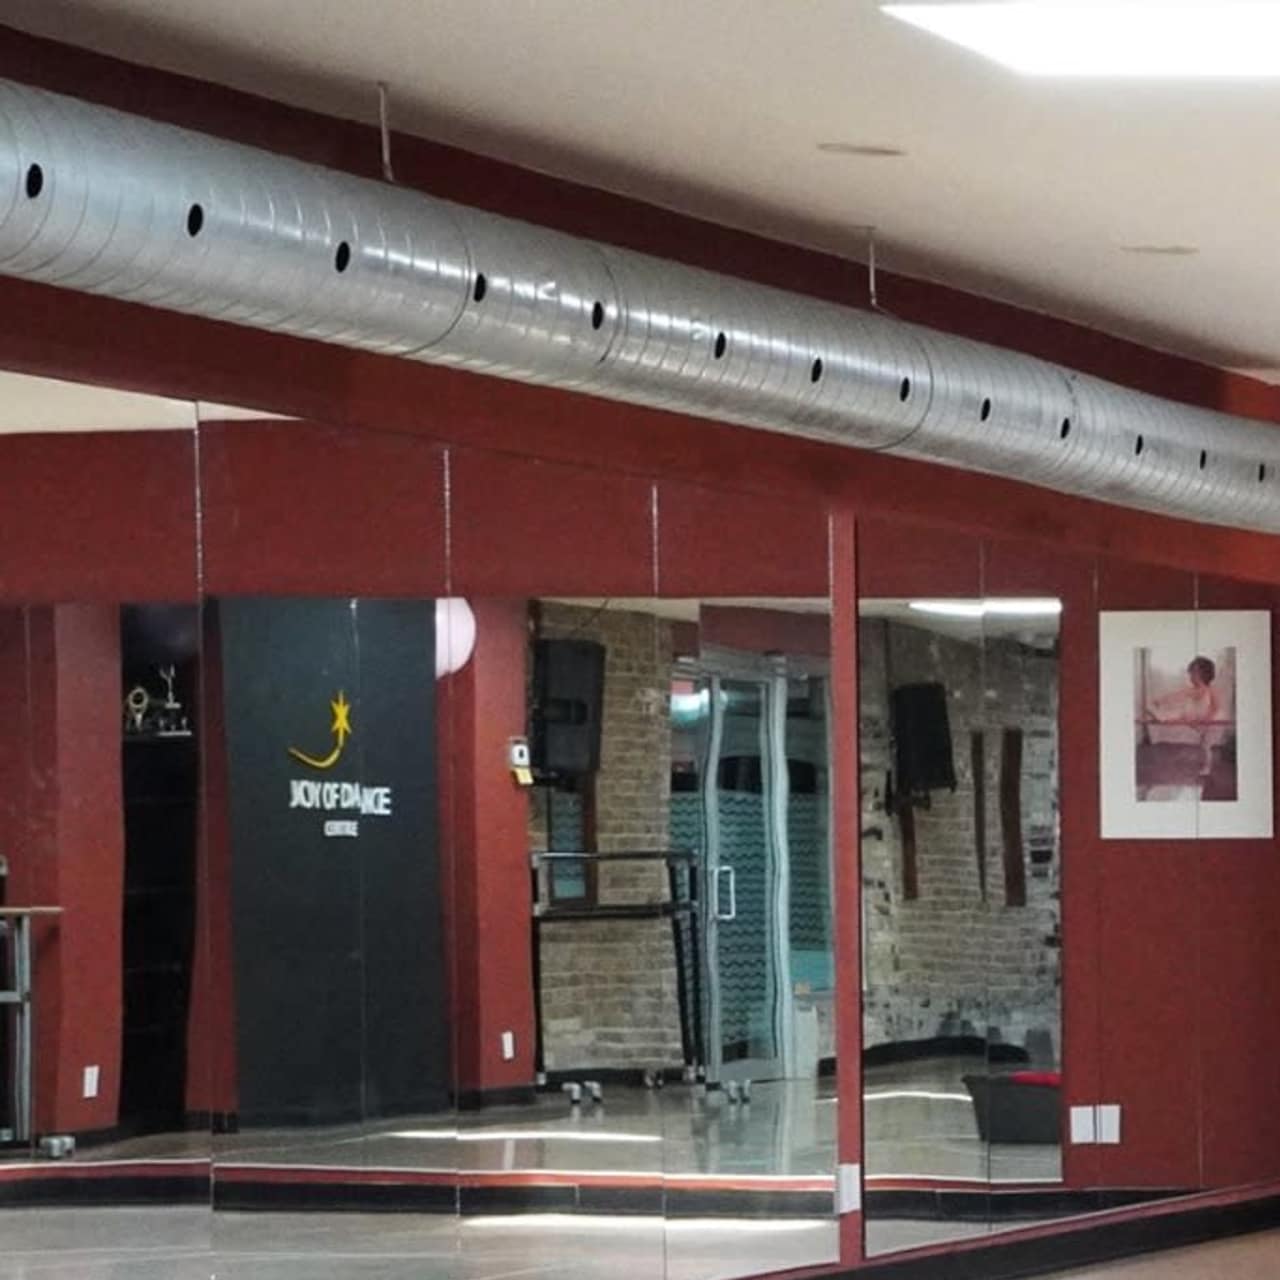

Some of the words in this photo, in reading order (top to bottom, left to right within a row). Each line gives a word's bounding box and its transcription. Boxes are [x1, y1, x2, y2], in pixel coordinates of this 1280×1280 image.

[289, 779, 321, 808] JOY
[322, 781, 340, 810] OF
[341, 781, 392, 815] DANCE
